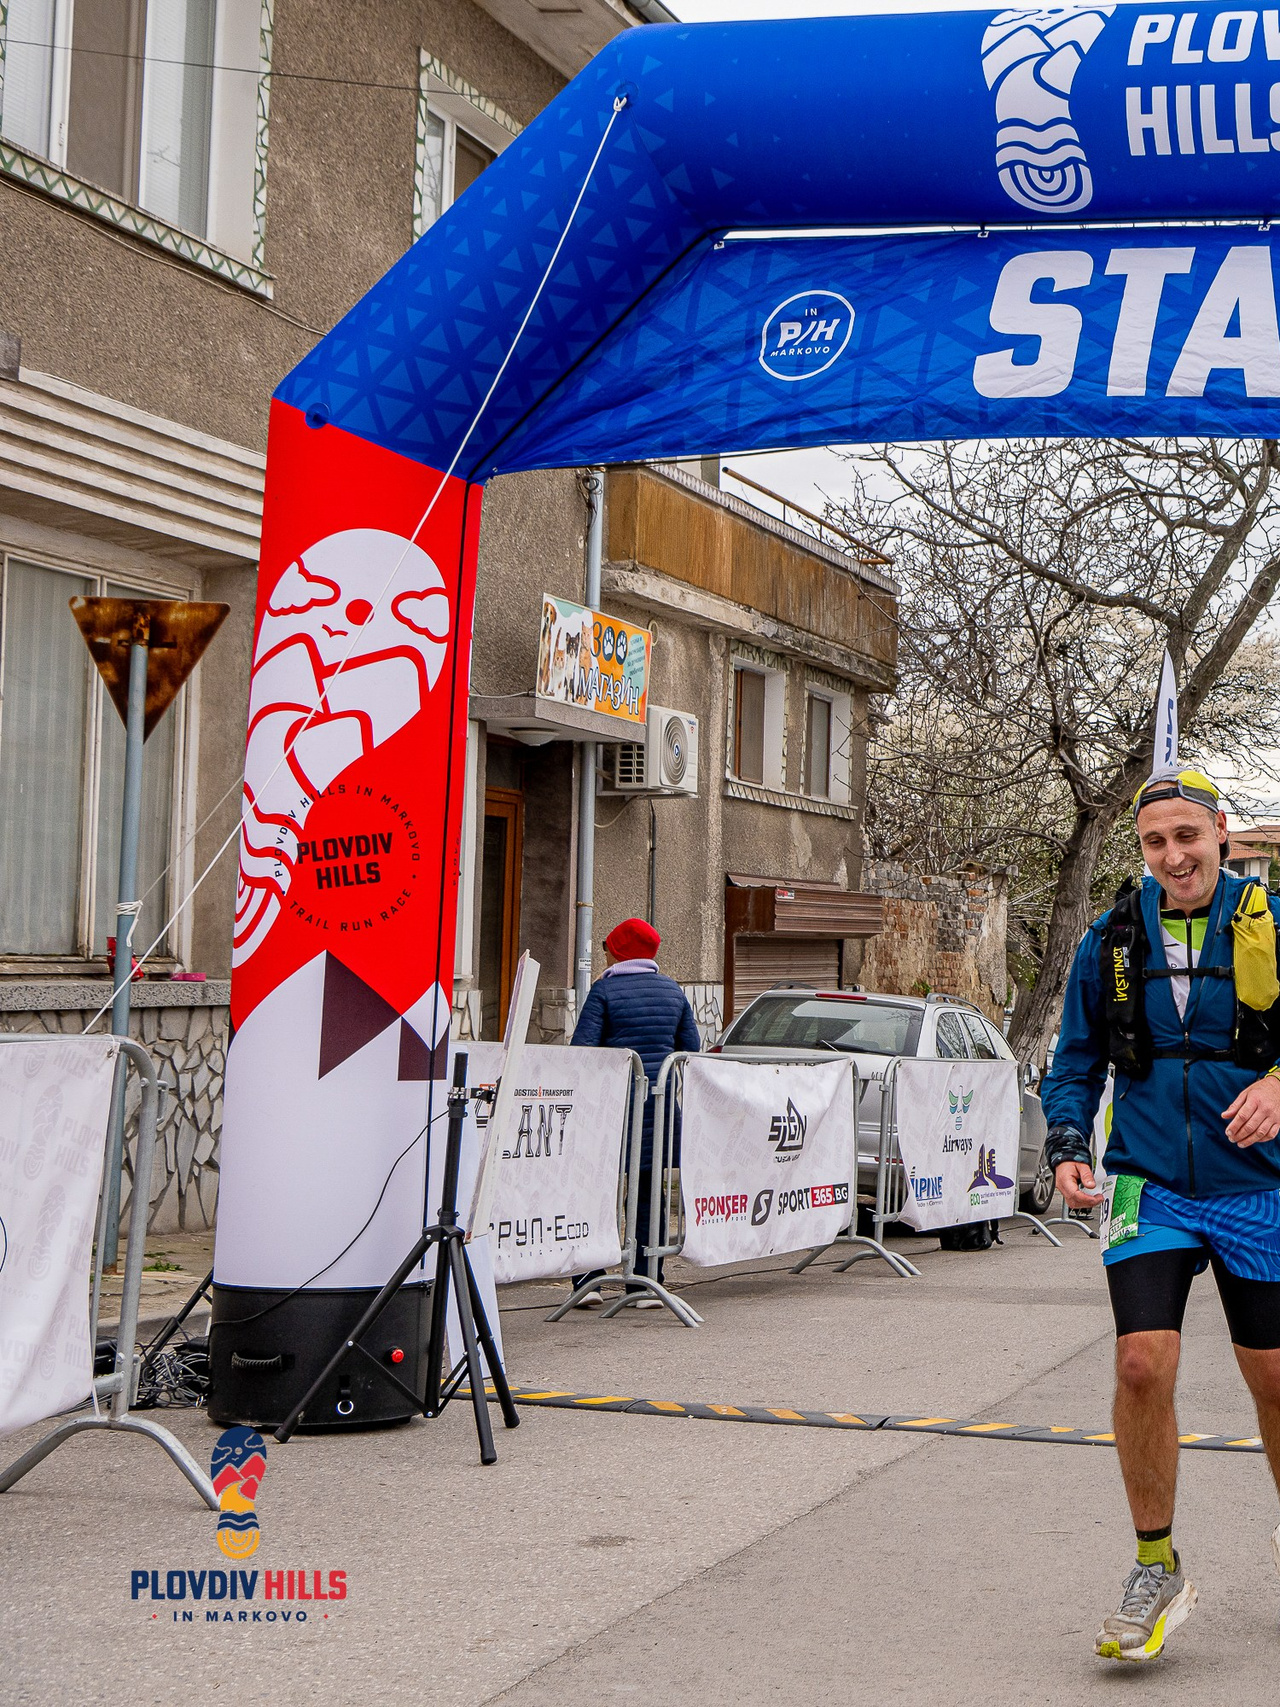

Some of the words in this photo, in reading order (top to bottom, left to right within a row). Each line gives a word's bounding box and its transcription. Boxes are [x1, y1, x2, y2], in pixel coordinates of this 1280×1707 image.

[805, 308, 818, 316] IN
[777, 318, 841, 348] P/H
[770, 346, 830, 357] MARKOVO
[578, 667, 639, 715] МАГАЗИН
[274, 809, 297, 877] PLOVDIV
[300, 784, 346, 808] HILLS
[356, 785, 373, 797] IN
[380, 794, 420, 861] MARKOVO
[296, 832, 393, 864] PLOVDIV
[316, 862, 381, 889] HILLS
[289, 900, 329, 930] TRAIL
[340, 918, 373, 931] RUN
[380, 889, 412, 921] RACE
[942, 1135, 973, 1155] Airways
[695, 1194, 748, 1226] SPONSER
